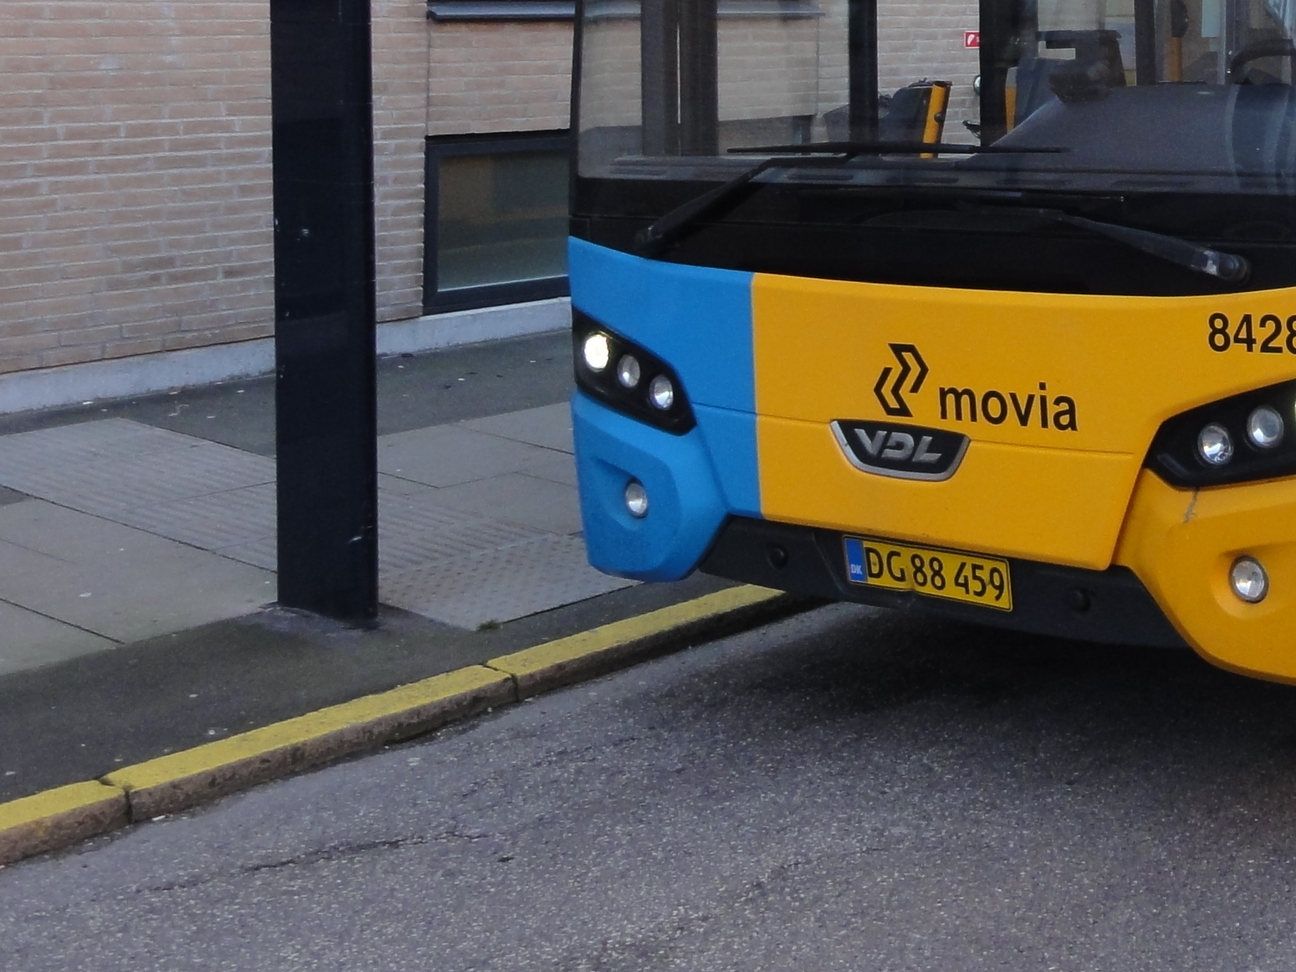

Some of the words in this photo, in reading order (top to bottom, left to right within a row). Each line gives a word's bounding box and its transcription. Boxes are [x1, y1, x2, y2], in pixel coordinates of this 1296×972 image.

[938, 381, 1078, 432] movia
[853, 428, 942, 464] VDL
[850, 563, 863, 576] DK
[864, 546, 906, 582] DG
[910, 553, 946, 590] 88
[954, 561, 1005, 602] 459
